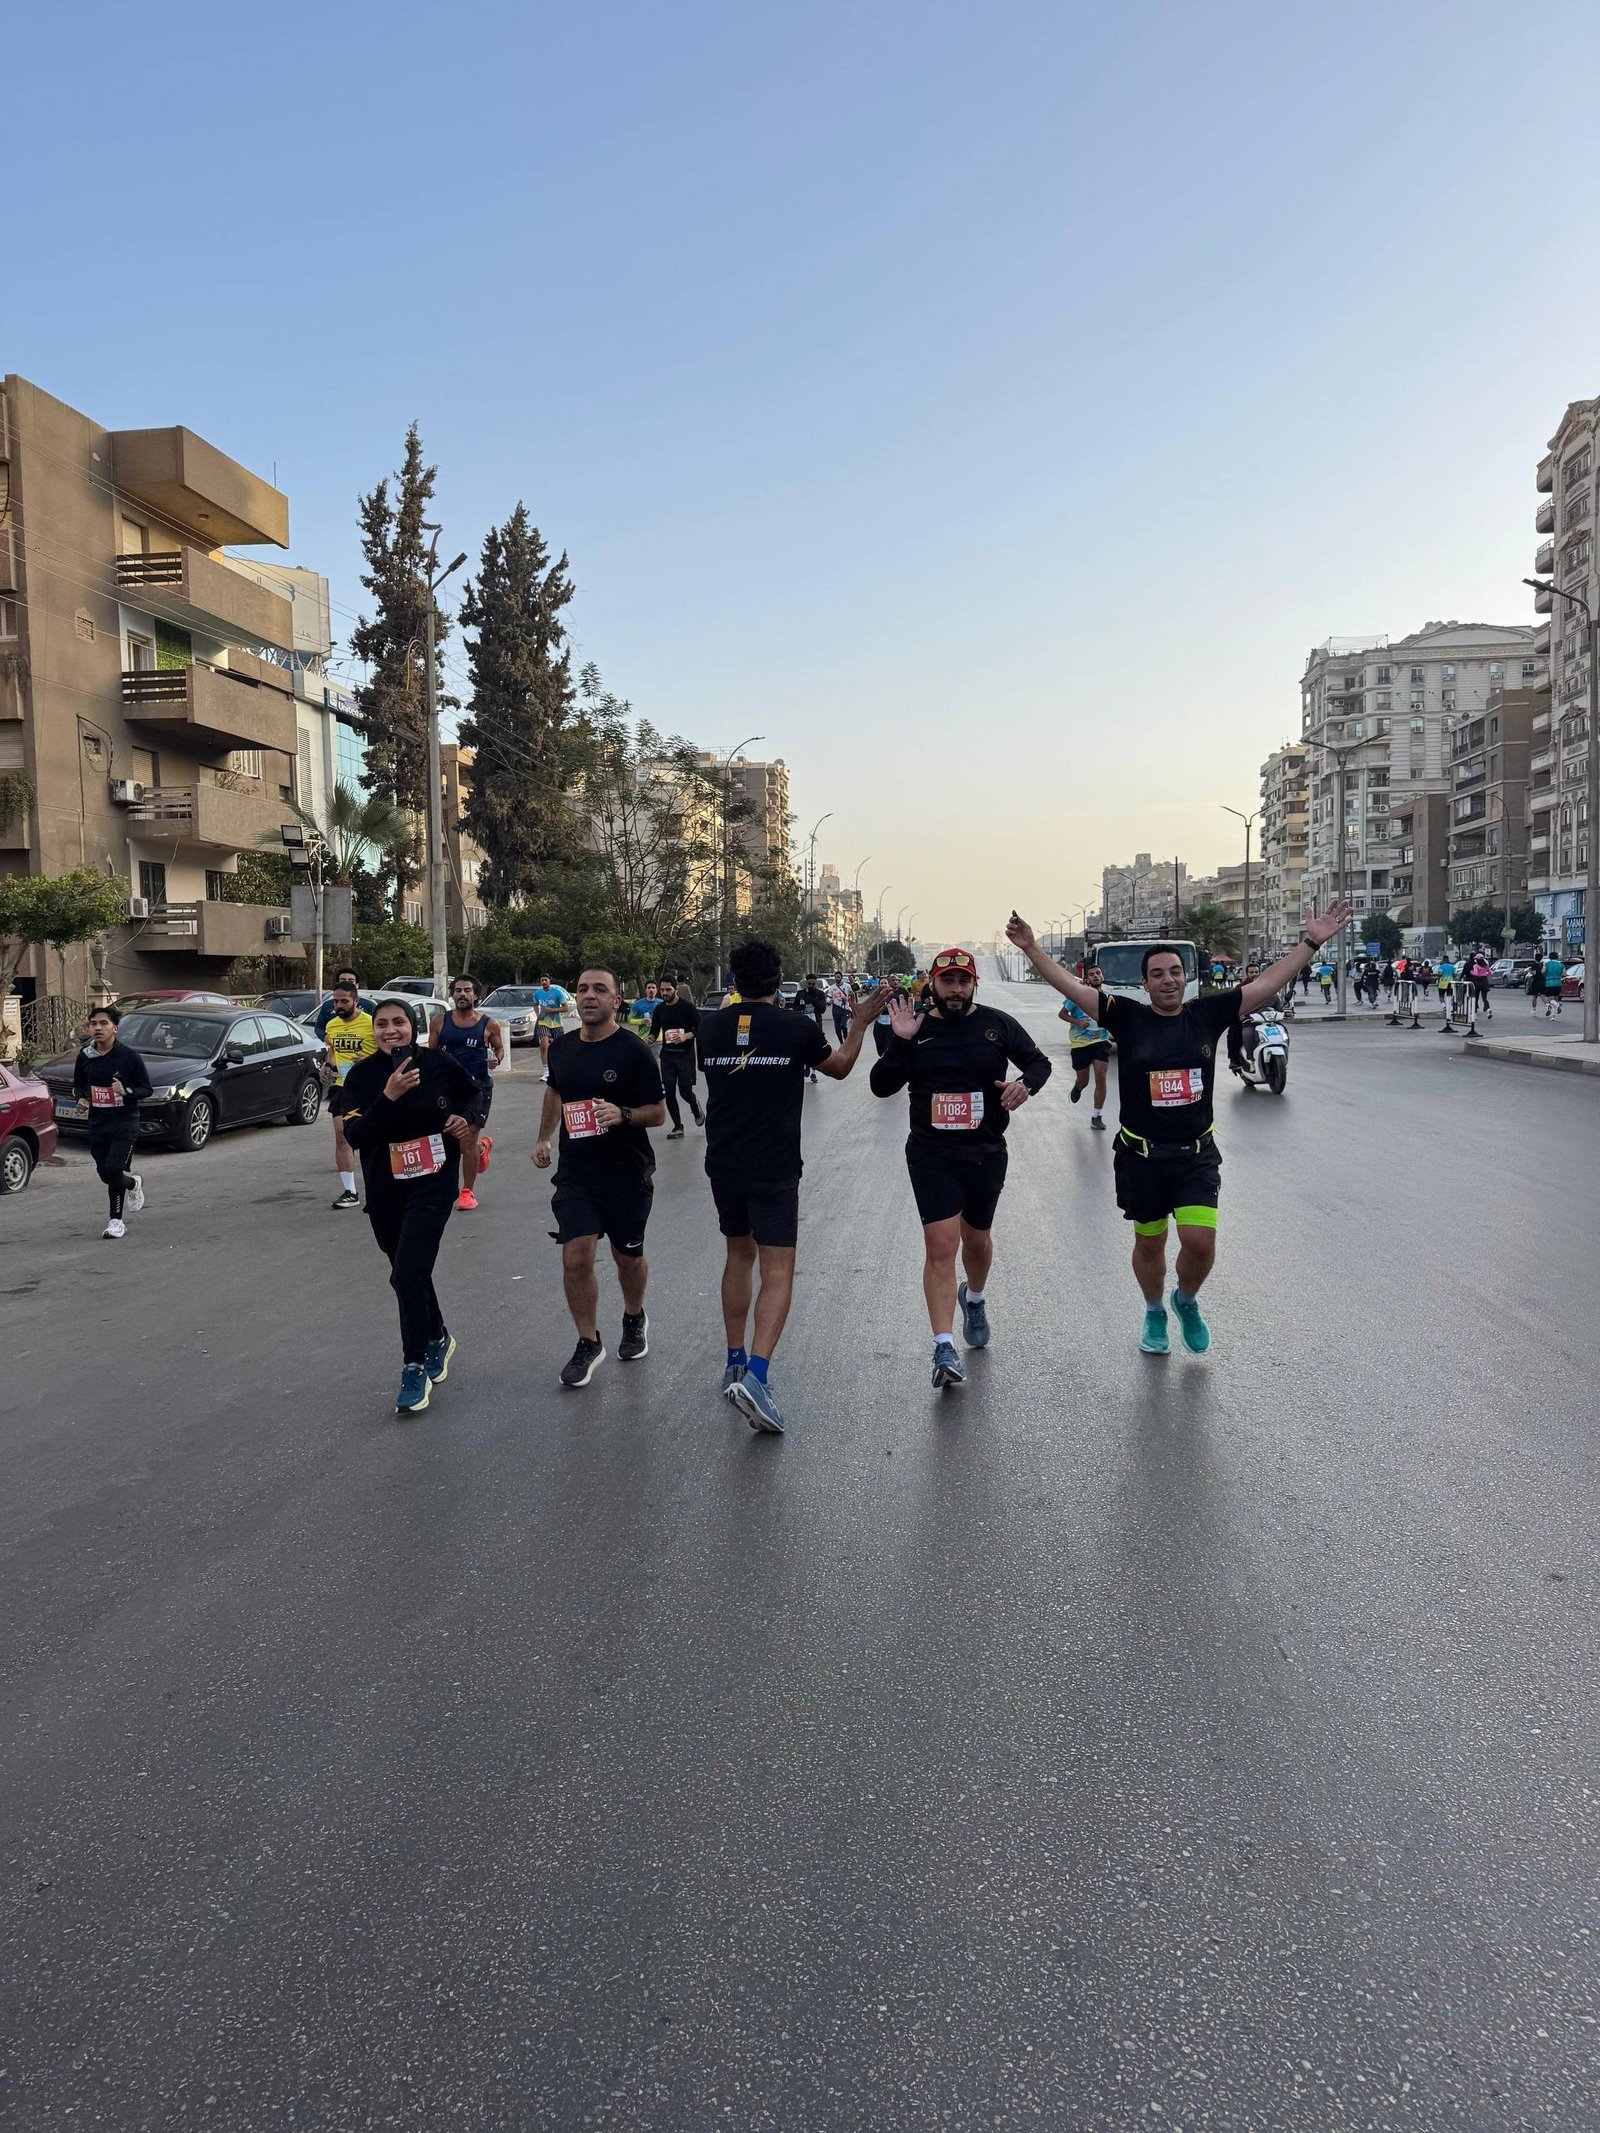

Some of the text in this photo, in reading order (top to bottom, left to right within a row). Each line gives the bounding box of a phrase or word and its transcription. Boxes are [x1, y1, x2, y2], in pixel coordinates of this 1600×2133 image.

[716, 1057, 747, 1066] UNITED
[748, 1057, 791, 1066] RUNNERS
[1159, 1079, 1184, 1093] 1944
[937, 1103, 967, 1116] 11082
[567, 1110, 591, 1126] 11081
[402, 1150, 421, 1165] 161
